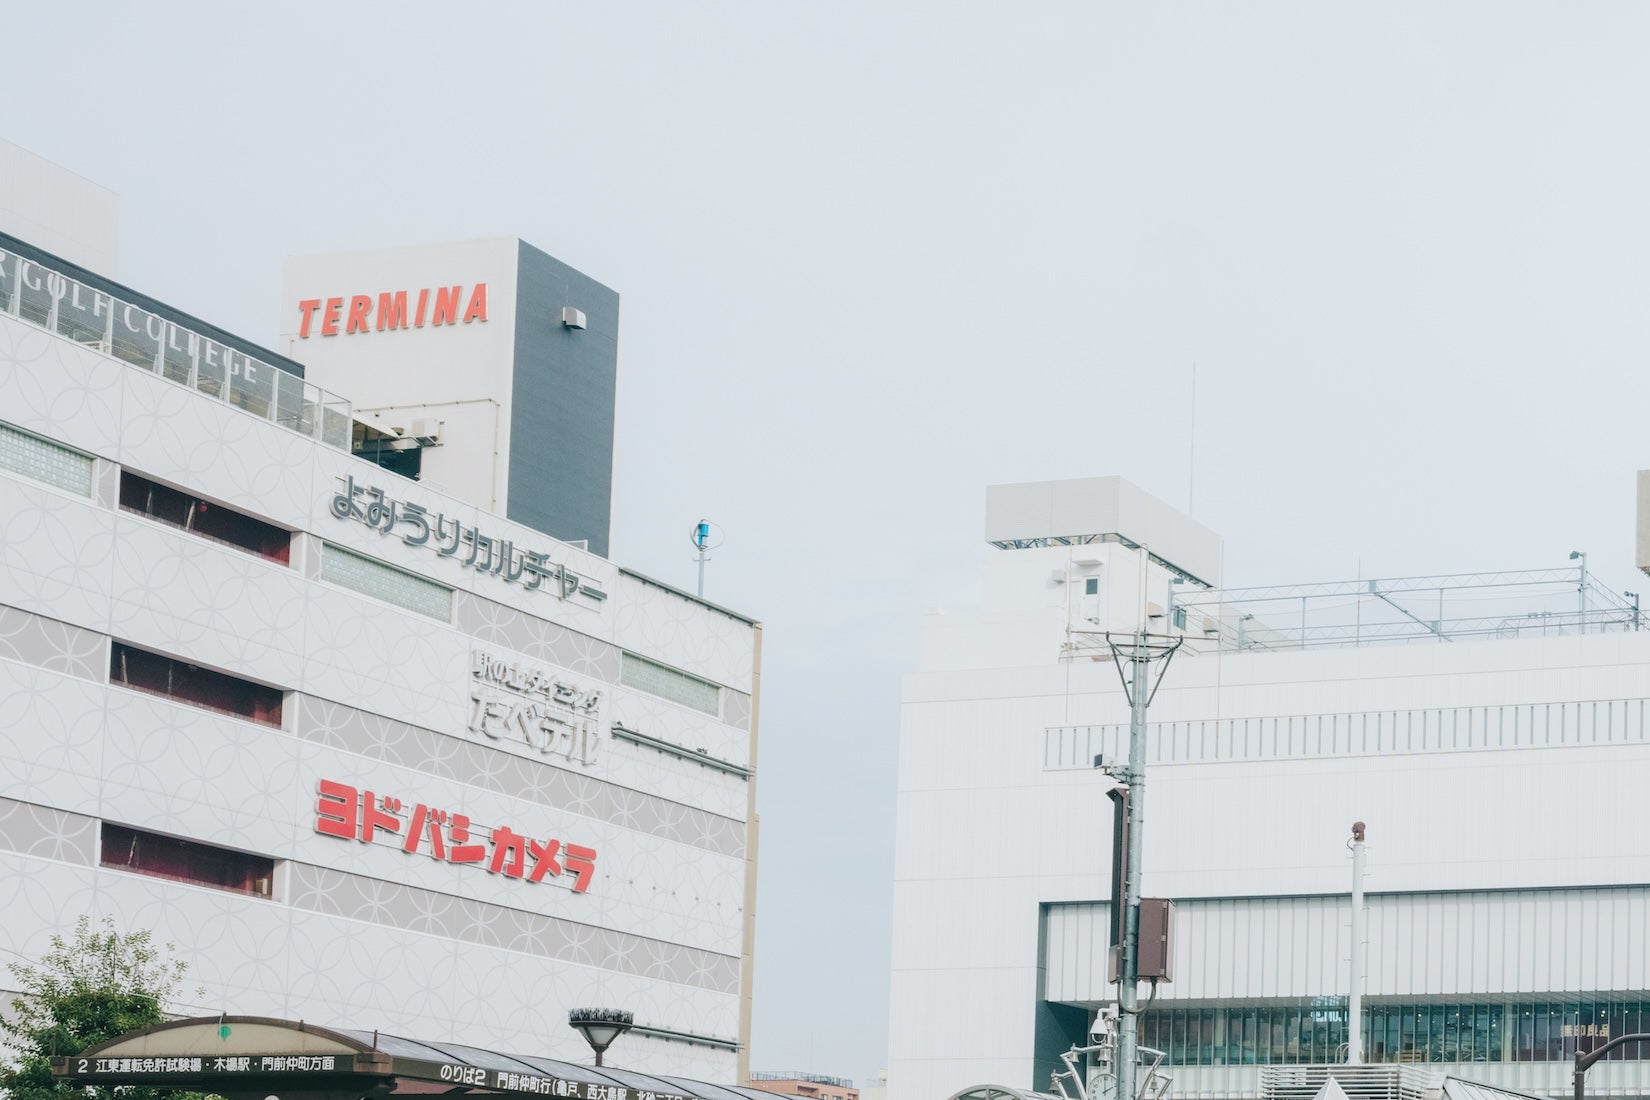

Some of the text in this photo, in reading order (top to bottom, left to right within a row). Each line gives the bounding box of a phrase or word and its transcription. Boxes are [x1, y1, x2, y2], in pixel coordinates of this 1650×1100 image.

[299, 282, 489, 339] TERMINA
[329, 474, 608, 600] よみうりカルチャー
[314, 779, 597, 893] ヨドバシカメラ
[78, 1060, 88, 1074] 2
[440, 1064, 486, 1087] のりば2
